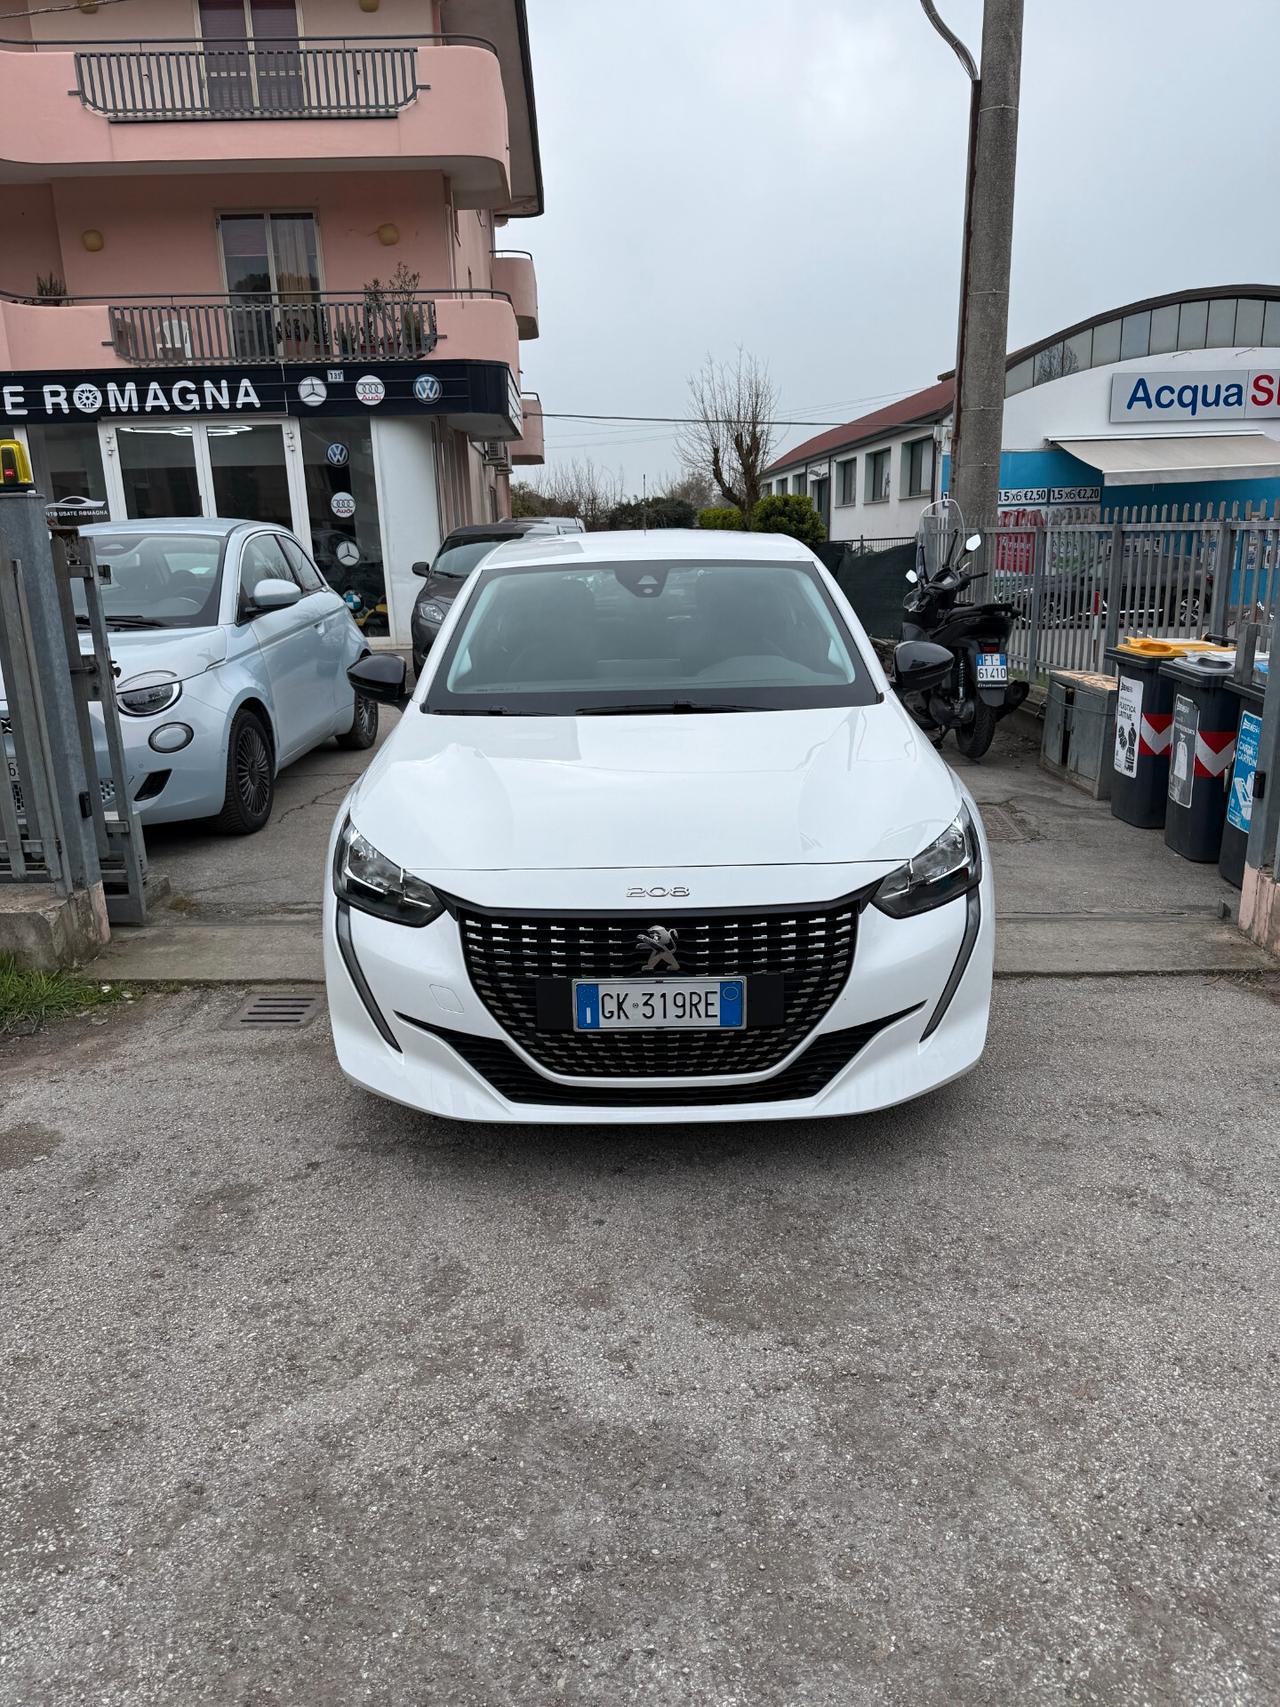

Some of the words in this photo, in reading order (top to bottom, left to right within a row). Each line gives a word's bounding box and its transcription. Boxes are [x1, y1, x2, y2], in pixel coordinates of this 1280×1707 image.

[42, 378, 261, 414] ROMAGNA
[1023, 489, 1046, 501] €2,50
[1051, 490, 1063, 501] 1,5
[1077, 488, 1100, 500] €2,20
[978, 667, 1007, 679] 61410
[626, 886, 690, 898] 208
